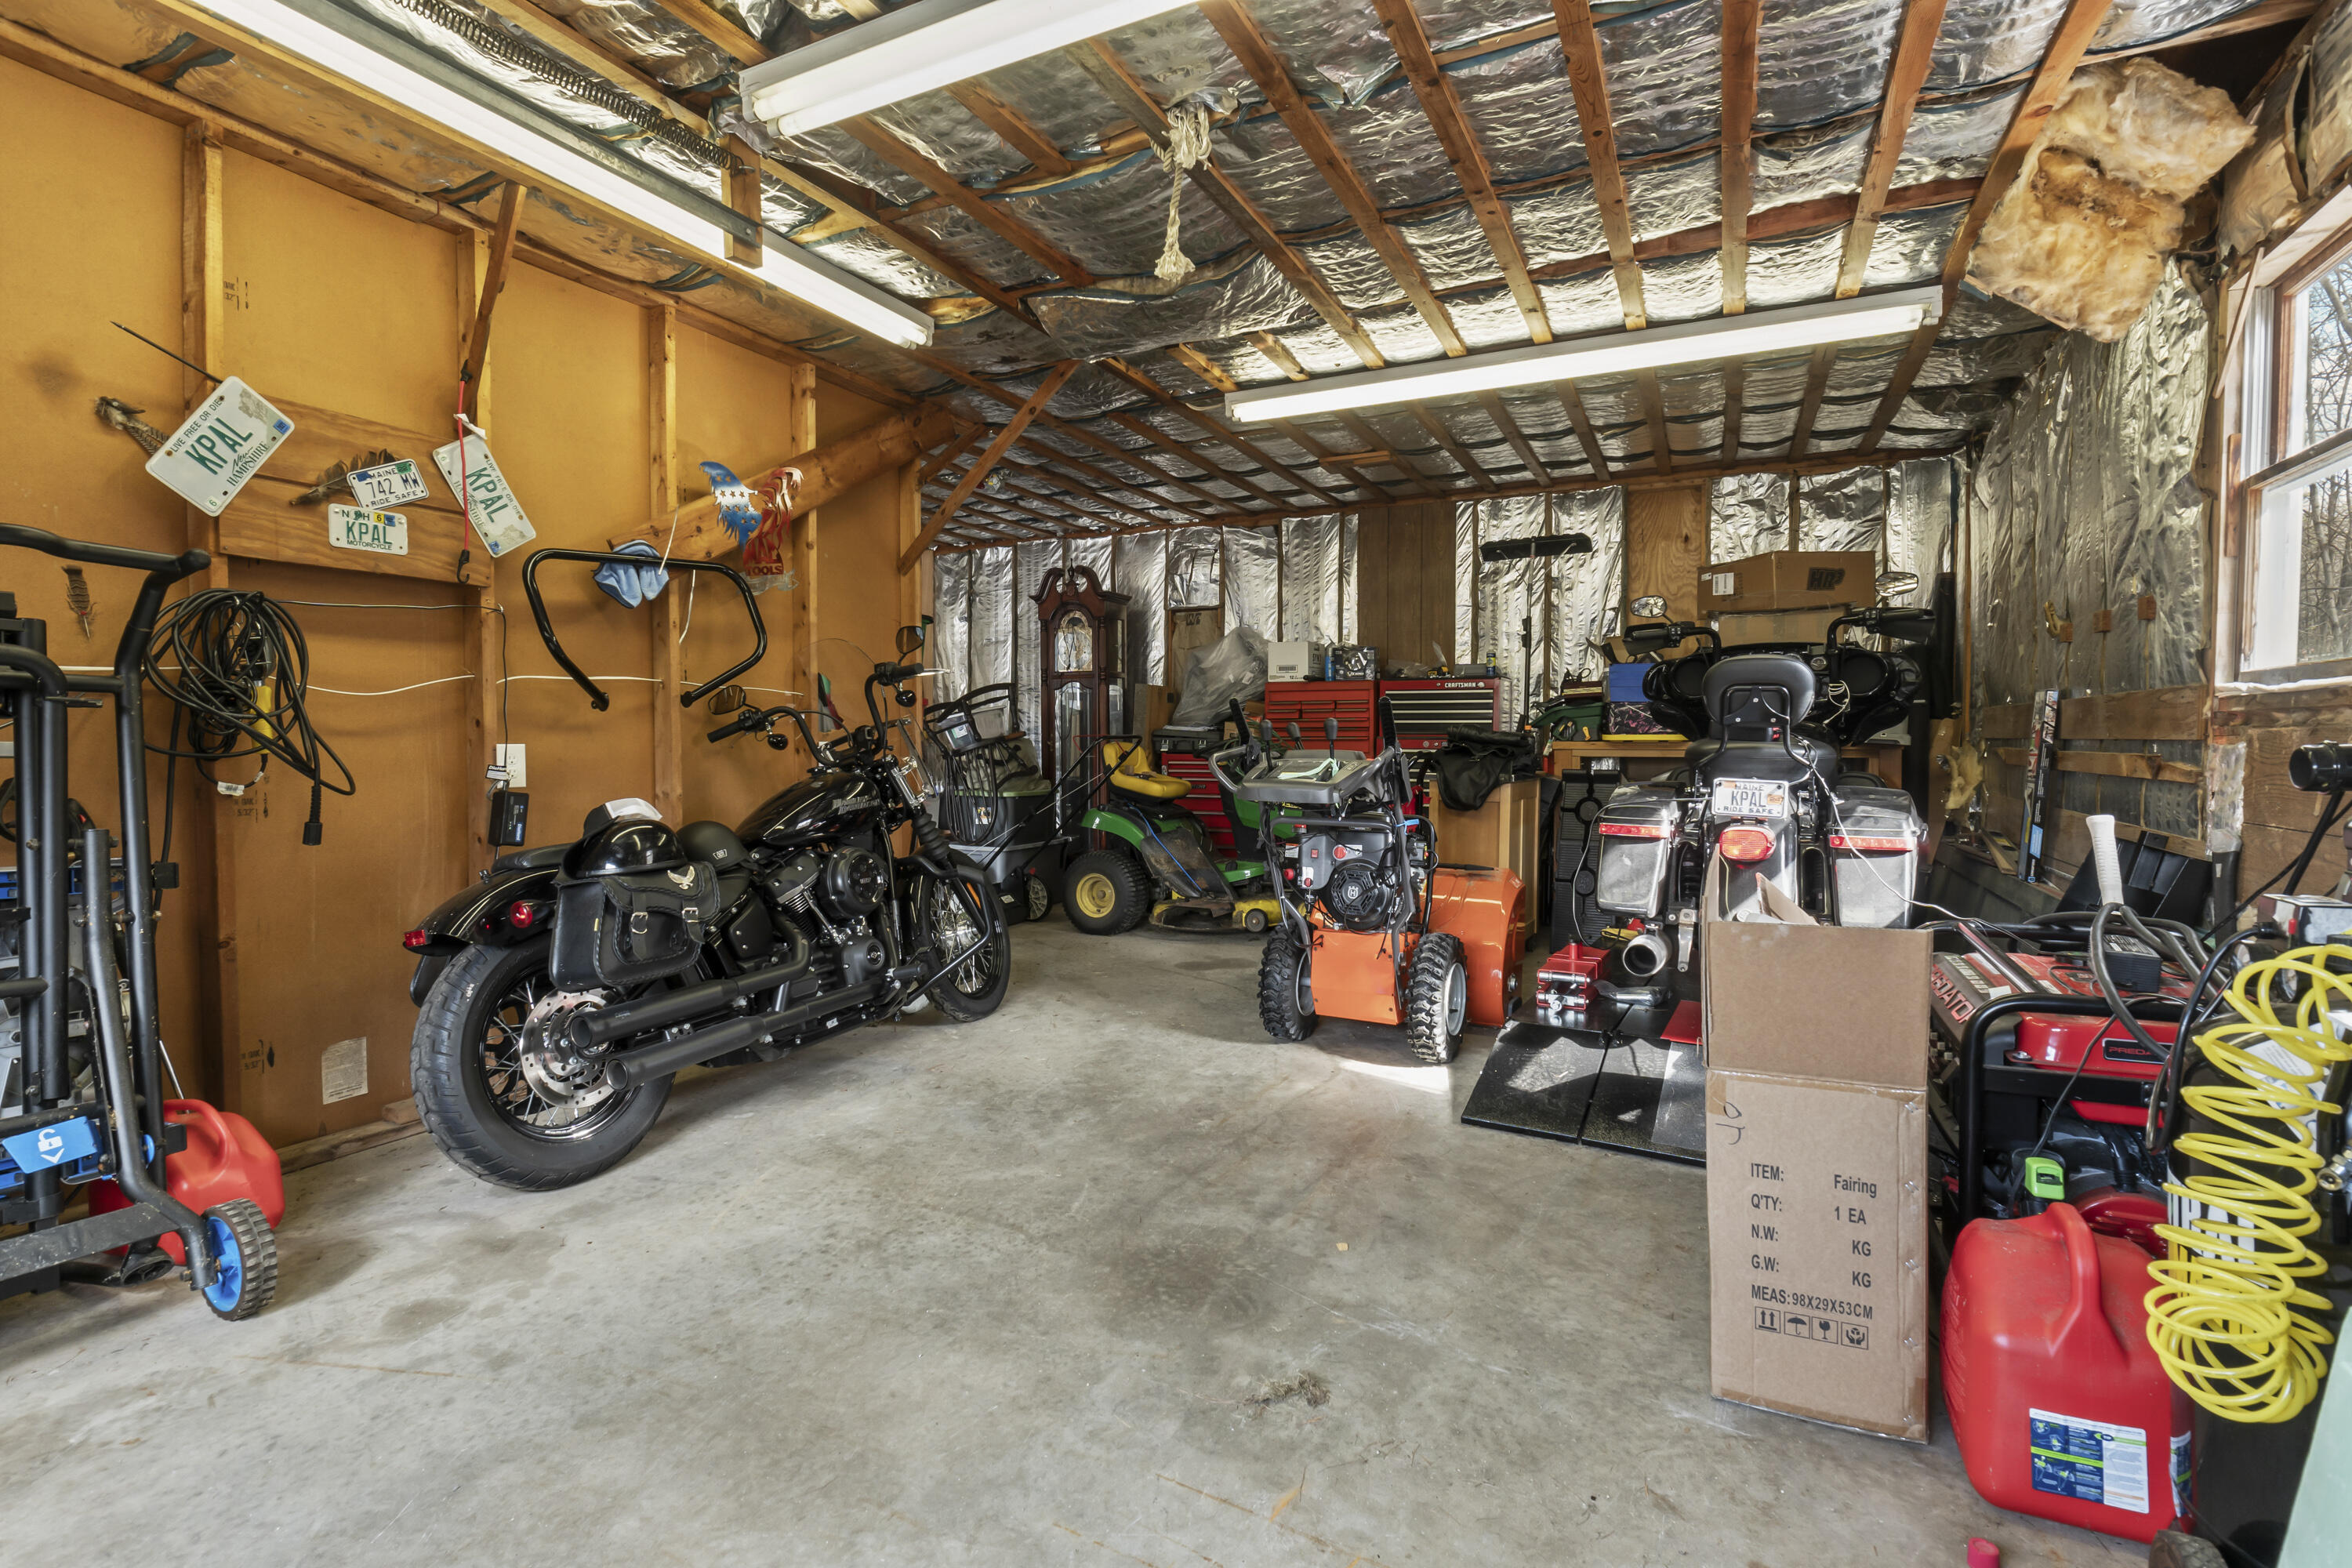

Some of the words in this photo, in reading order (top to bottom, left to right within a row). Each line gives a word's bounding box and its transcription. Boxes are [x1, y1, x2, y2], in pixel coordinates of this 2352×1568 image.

[169, 437, 186, 453] LIVE
[184, 421, 201, 439] FREE
[199, 410, 212, 422] OR
[209, 398, 223, 412] DIE
[184, 417, 253, 475] KPAL
[227, 441, 269, 486] HAMPSHIRE
[369, 467, 397, 479] MAINE
[365, 477, 395, 499] 742
[400, 471, 420, 491] MW
[371, 496, 391, 507] RIDE
[395, 490, 418, 501] SAFE
[466, 466, 509, 523] KPAL
[347, 520, 393, 545] KPAL
[347, 539, 393, 550] MOTORCYCLE
[746, 564, 783, 576] TOOLS
[1731, 790, 1766, 808] KPAL
[1751, 1163, 1784, 1181] ITEM:
[1834, 1174, 1878, 1199] Fairing
[1751, 1193, 1783, 1212] Q'TY:
[1835, 1206, 1841, 1221] 1
[1849, 1208, 1867, 1225] EA
[1751, 1224, 1779, 1242] N.W:
[1852, 1240, 1871, 1257] KG
[1751, 1254, 1780, 1272] G.W:
[1852, 1271, 1871, 1288] KG
